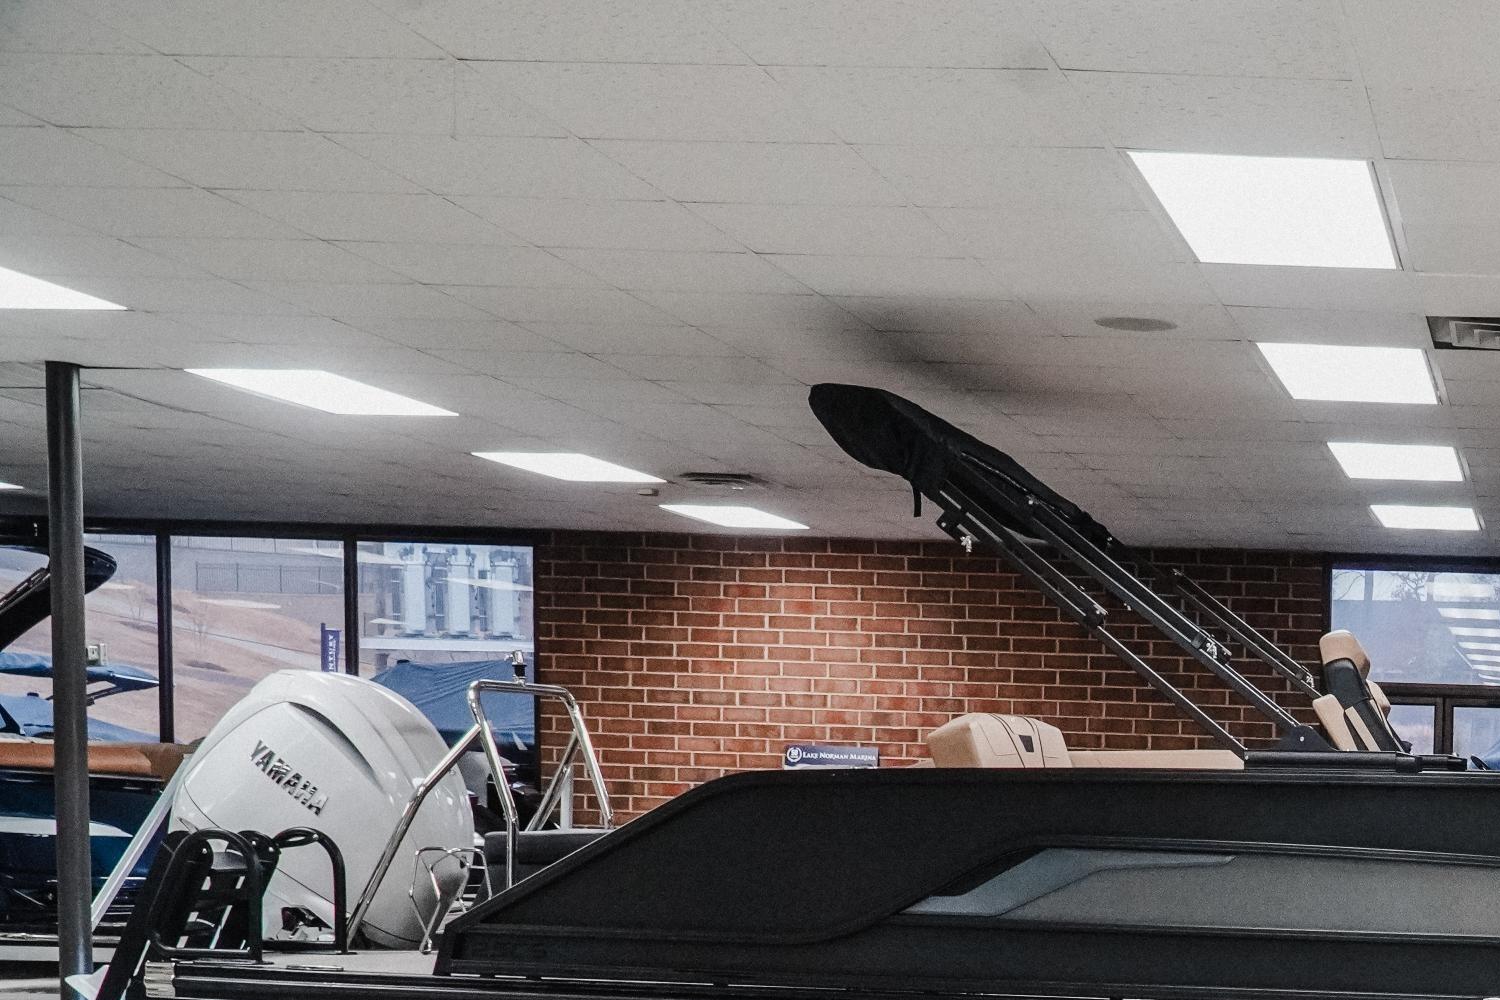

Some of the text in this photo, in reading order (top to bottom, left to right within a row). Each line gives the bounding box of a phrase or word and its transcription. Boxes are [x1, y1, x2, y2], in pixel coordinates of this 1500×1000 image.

[250, 739, 328, 816] YAMAHA
[802, 751, 876, 761] LAKE NORMAN MARINA
